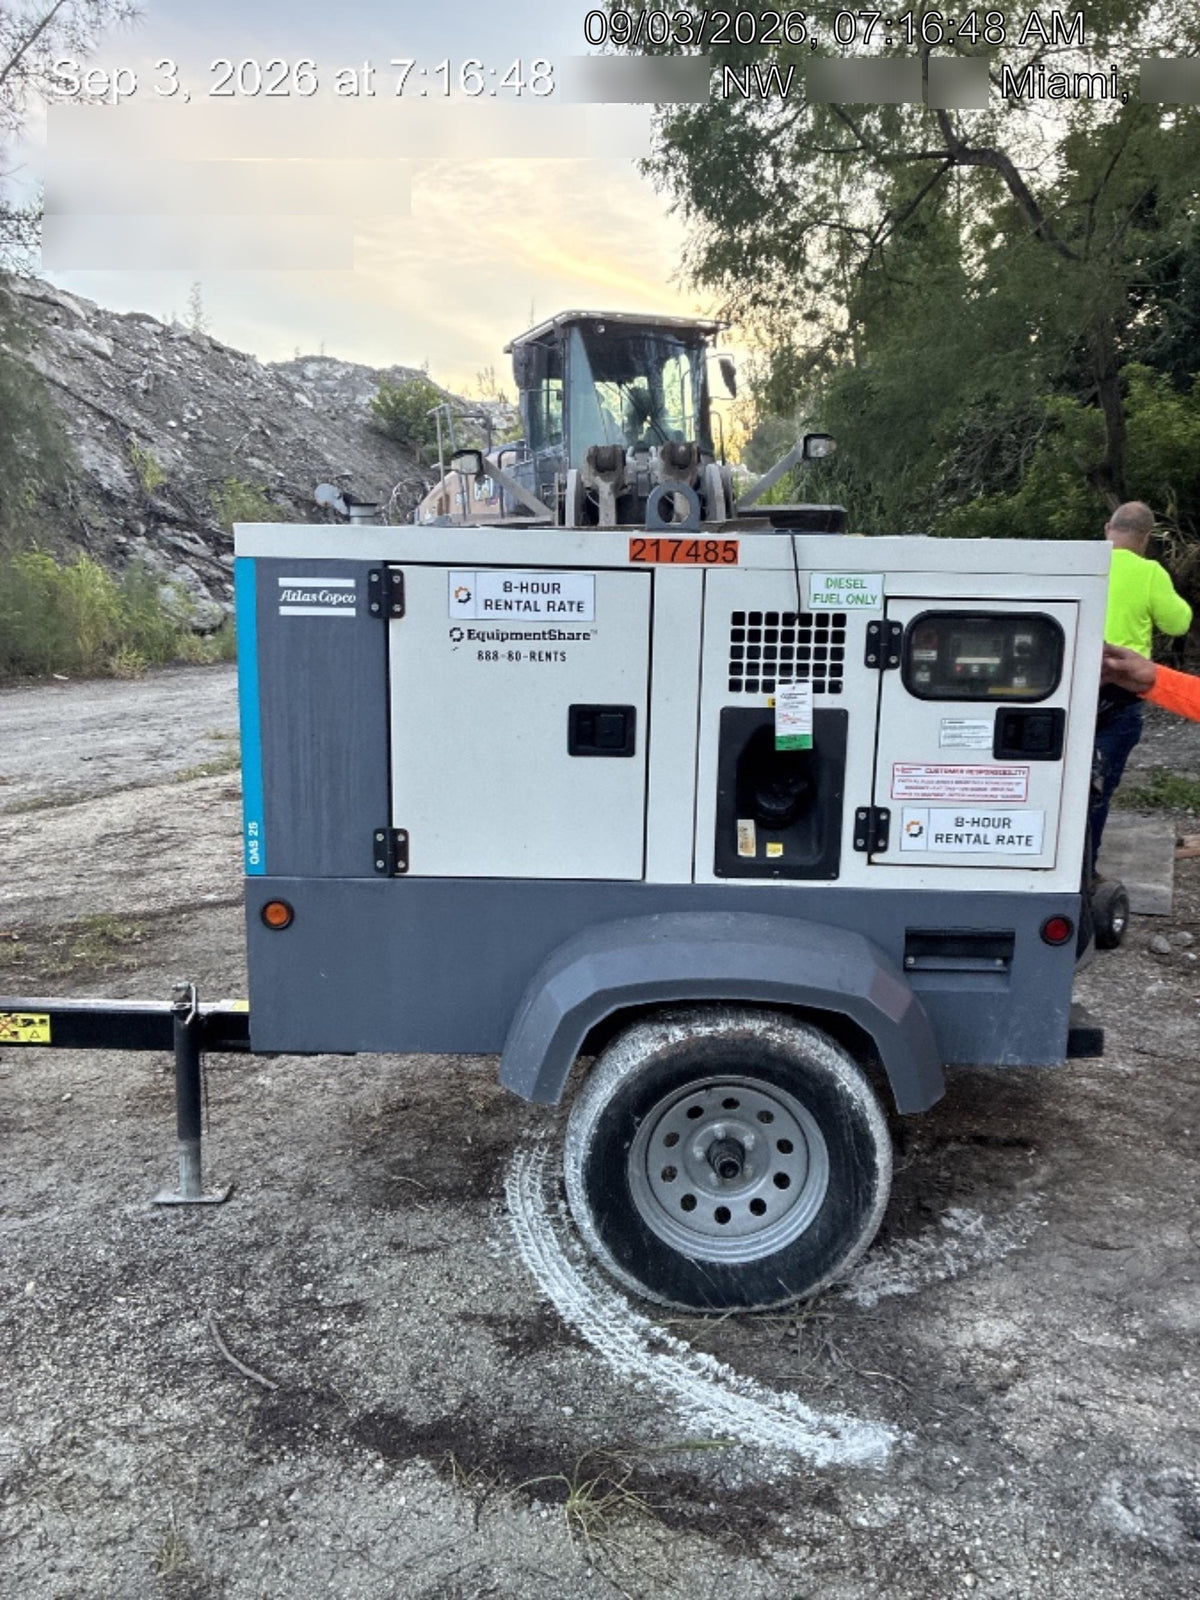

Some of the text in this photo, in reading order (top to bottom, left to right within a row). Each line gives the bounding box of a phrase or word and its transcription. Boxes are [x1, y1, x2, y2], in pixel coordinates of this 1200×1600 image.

[630, 538, 738, 563] 217485
[502, 581, 561, 594] 8-HOUR
[825, 577, 867, 590] DIESEL
[280, 589, 357, 605] Atlas Copco
[812, 593, 878, 606] FUEL ONLY
[483, 599, 585, 613] RENTAL RATE
[477, 650, 567, 662] 888-80-RENTS
[954, 816, 1012, 829] 8-HOUR
[934, 833, 1034, 847] RENTAL RATE
